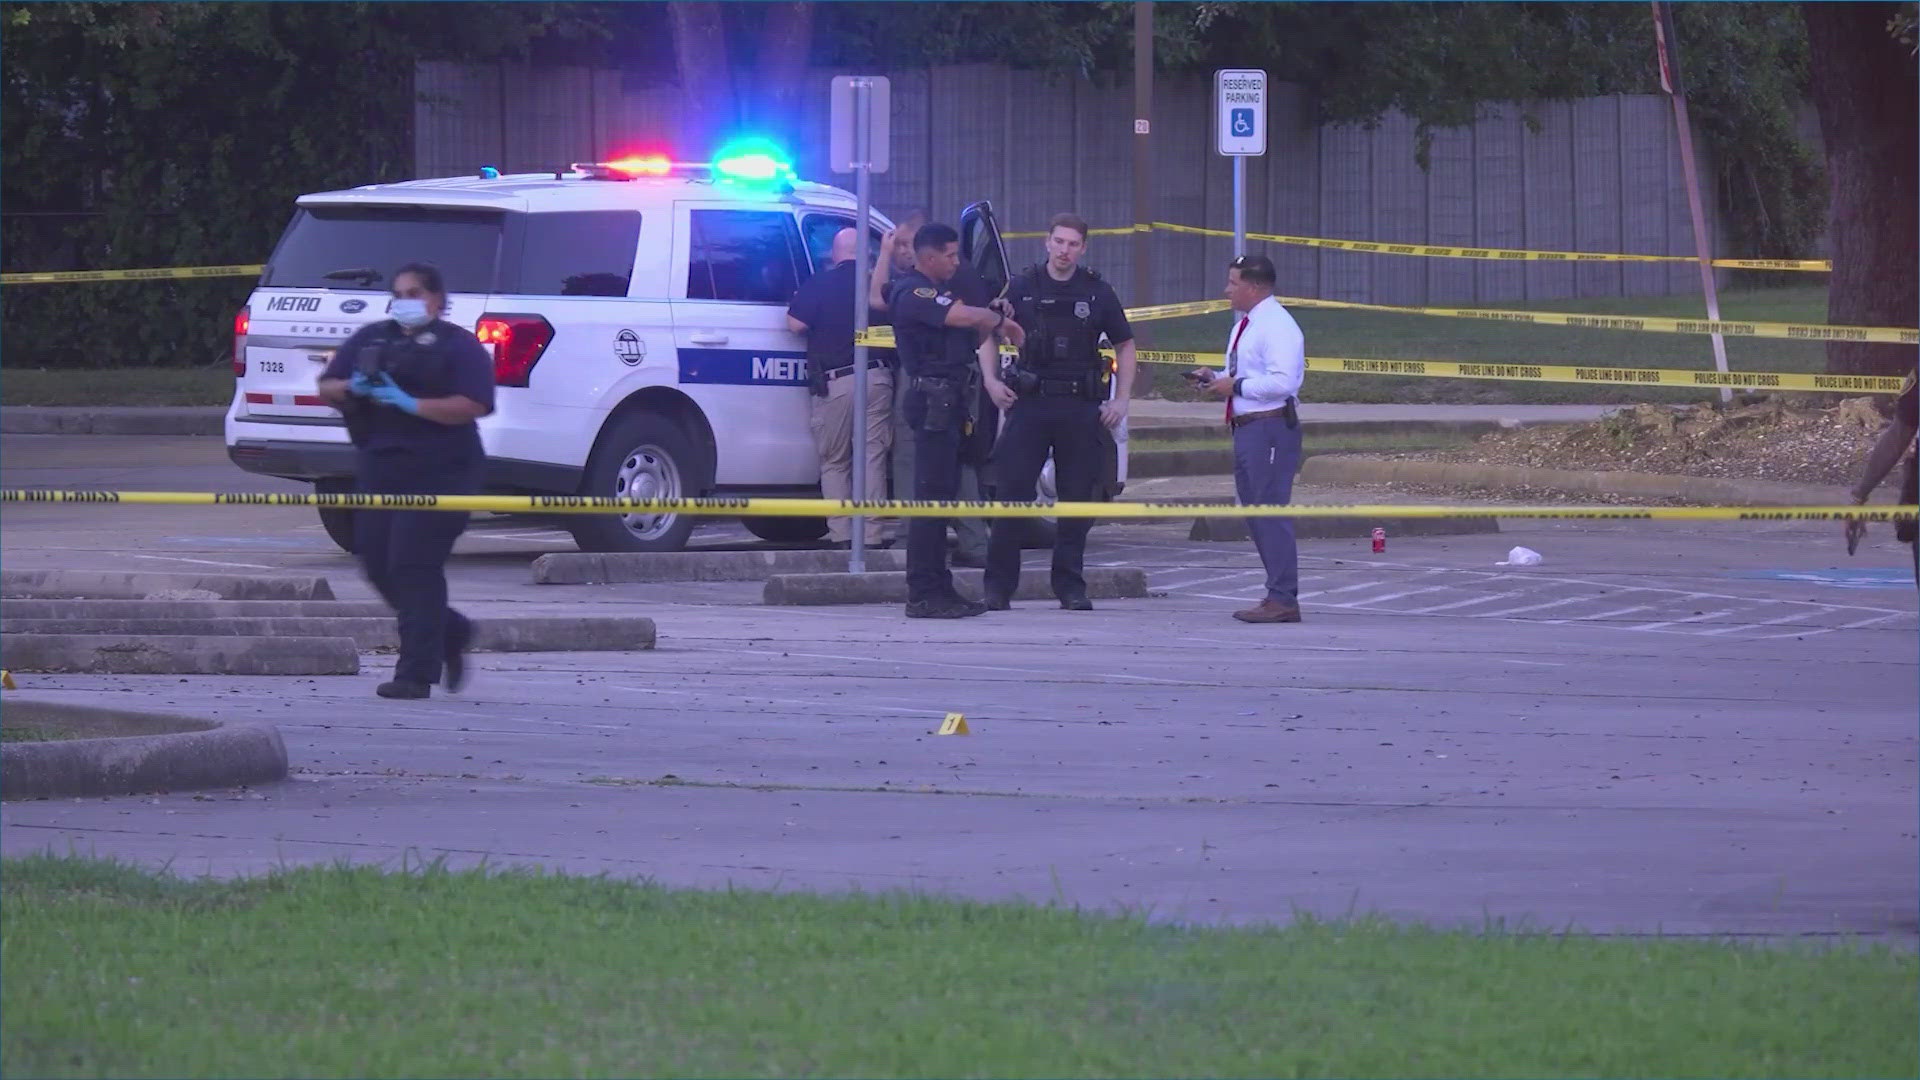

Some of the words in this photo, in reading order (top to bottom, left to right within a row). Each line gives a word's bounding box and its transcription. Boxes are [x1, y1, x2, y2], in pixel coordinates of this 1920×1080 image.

[1223, 79, 1262, 90] RESERVED
[1226, 93, 1260, 103] PARKING
[266, 296, 322, 312] METRO
[290, 325, 352, 334] EXPED
[1676, 322, 1696, 332] CROSS
[1698, 323, 1709, 333] NOT
[1711, 323, 1719, 333] DO
[1720, 324, 1733, 335] LINE
[1735, 325, 1755, 336] POLICE
[1788, 326, 1808, 337] CROSS
[1809, 327, 1821, 338] NOT
[1823, 328, 1831, 338] DO
[1832, 328, 1845, 339] LINE
[1846, 329, 1867, 340] POLICE
[1137, 352, 1151, 361] LINE
[1151, 352, 1160, 361] DO
[1161, 353, 1173, 362] NOT
[1174, 353, 1196, 363] CROSS
[260, 361, 284, 373] 7328
[752, 357, 808, 380] METR
[1343, 360, 1364, 371] POLICE
[1366, 360, 1379, 371] LINE
[1380, 361, 1389, 372] DO
[1390, 361, 1402, 372] NOT
[1404, 362, 1425, 373] CROSS
[1459, 364, 1480, 375] POLICE
[1482, 365, 1495, 376] LINE
[1496, 365, 1504, 377] DO
[1506, 366, 1518, 377] NOT
[1520, 366, 1541, 378] CROSS
[1576, 368, 1597, 379] POLICE
[1599, 369, 1612, 380] LINE
[1614, 370, 1622, 381] DO
[1624, 370, 1636, 381] NOT
[1638, 371, 1659, 382] CROSS
[1695, 373, 1716, 384] POLICE
[1718, 373, 1731, 384] LINE
[1733, 374, 1741, 385] DO
[1743, 374, 1756, 385] NOT
[1757, 375, 1779, 386] CROSS
[1815, 376, 1836, 387] POLICE
[1838, 377, 1851, 388] LINE
[1853, 378, 1861, 389] DO
[1863, 378, 1876, 389] NOT
[1878, 378, 1901, 390] CROSS
